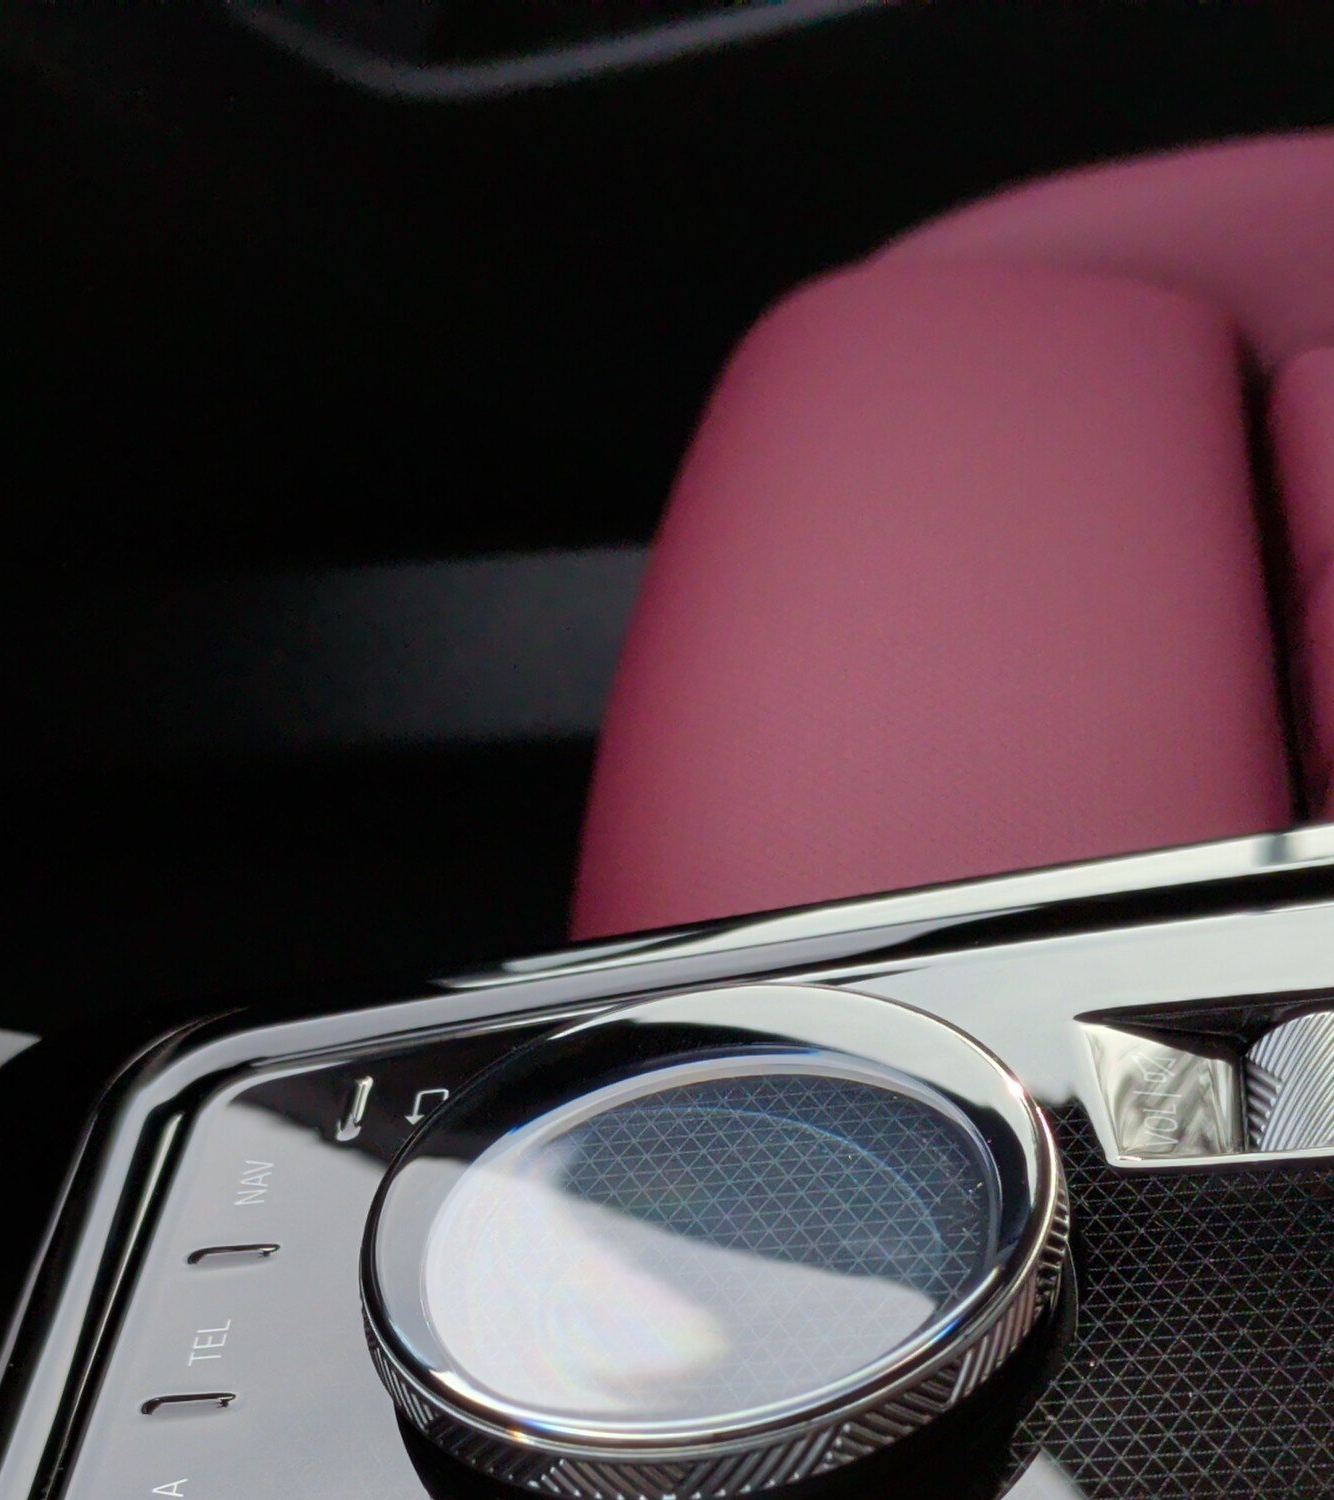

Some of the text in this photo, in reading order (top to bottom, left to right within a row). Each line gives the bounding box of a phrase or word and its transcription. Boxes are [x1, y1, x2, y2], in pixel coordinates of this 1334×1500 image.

[1144, 1103, 1179, 1146] VOL
[235, 1159, 275, 1207] NAV
[188, 1319, 232, 1367] TEL
